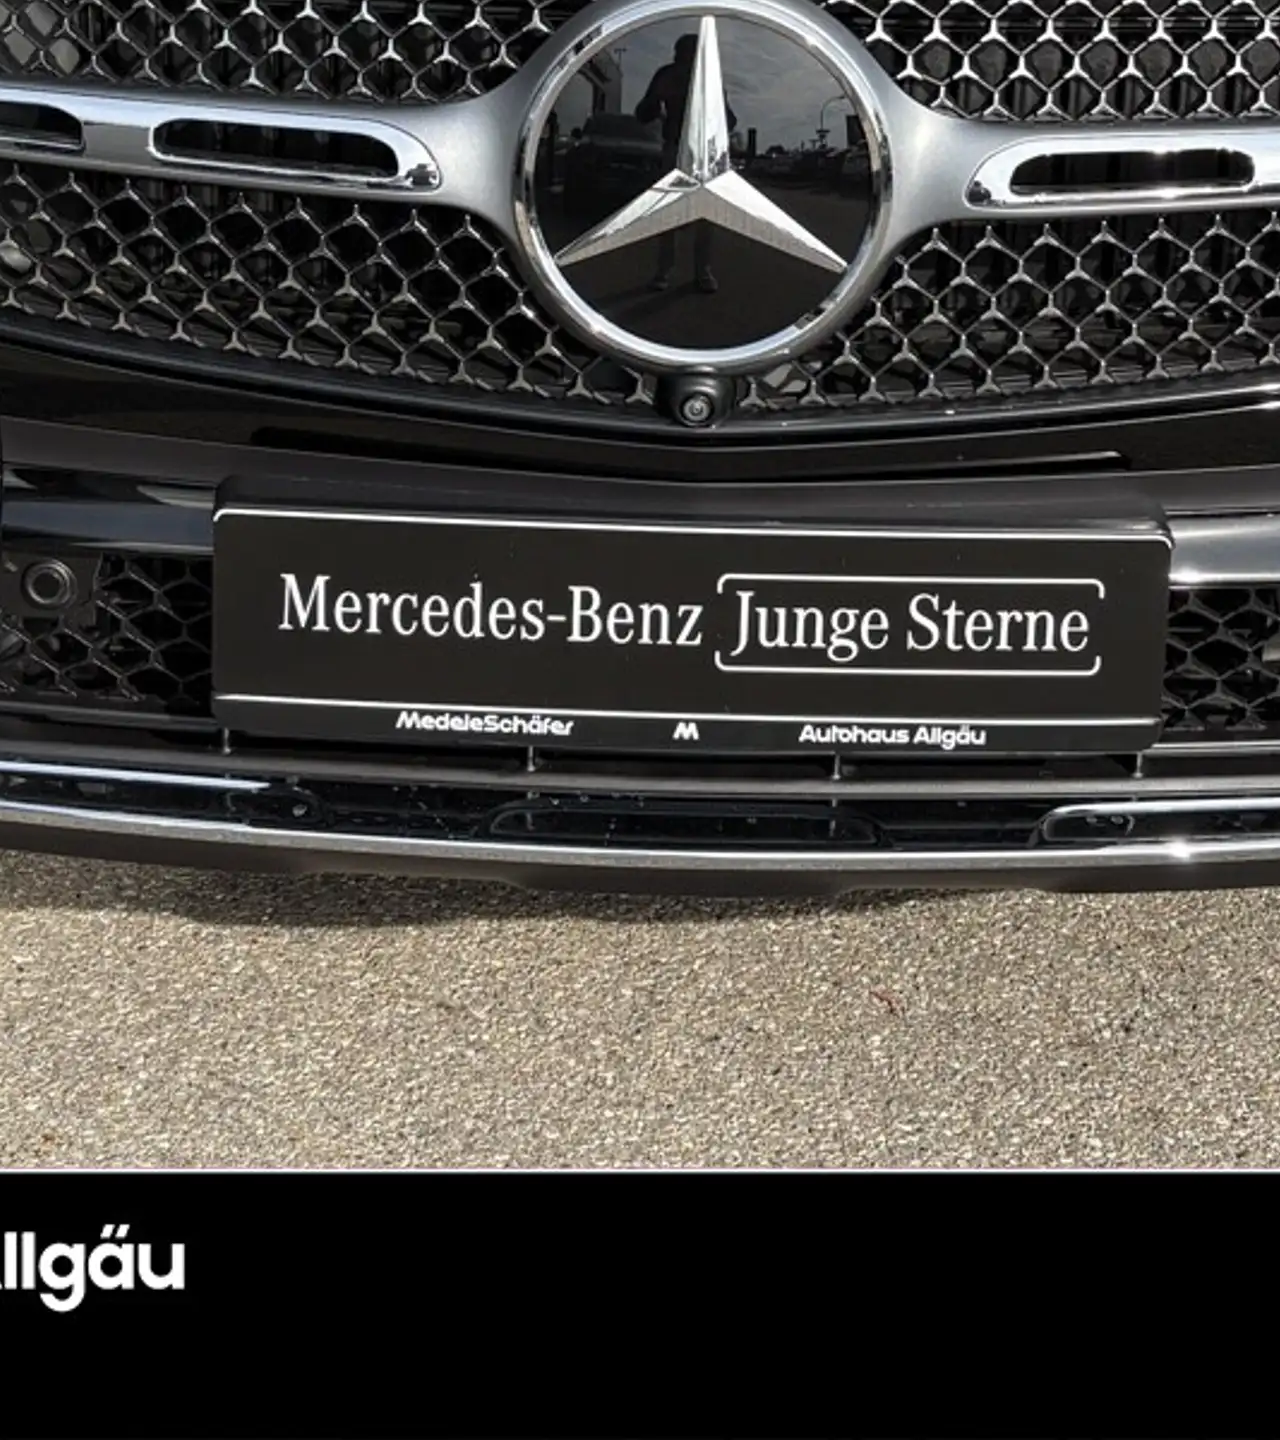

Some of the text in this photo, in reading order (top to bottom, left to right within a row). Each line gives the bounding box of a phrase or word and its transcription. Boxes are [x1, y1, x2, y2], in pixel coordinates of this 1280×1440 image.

[278, 573, 1090, 662] Mercedes-Benz Junge Sterne
[395, 710, 574, 737] MedeleSchäfer
[799, 723, 987, 750] Autohaus Allgäu
